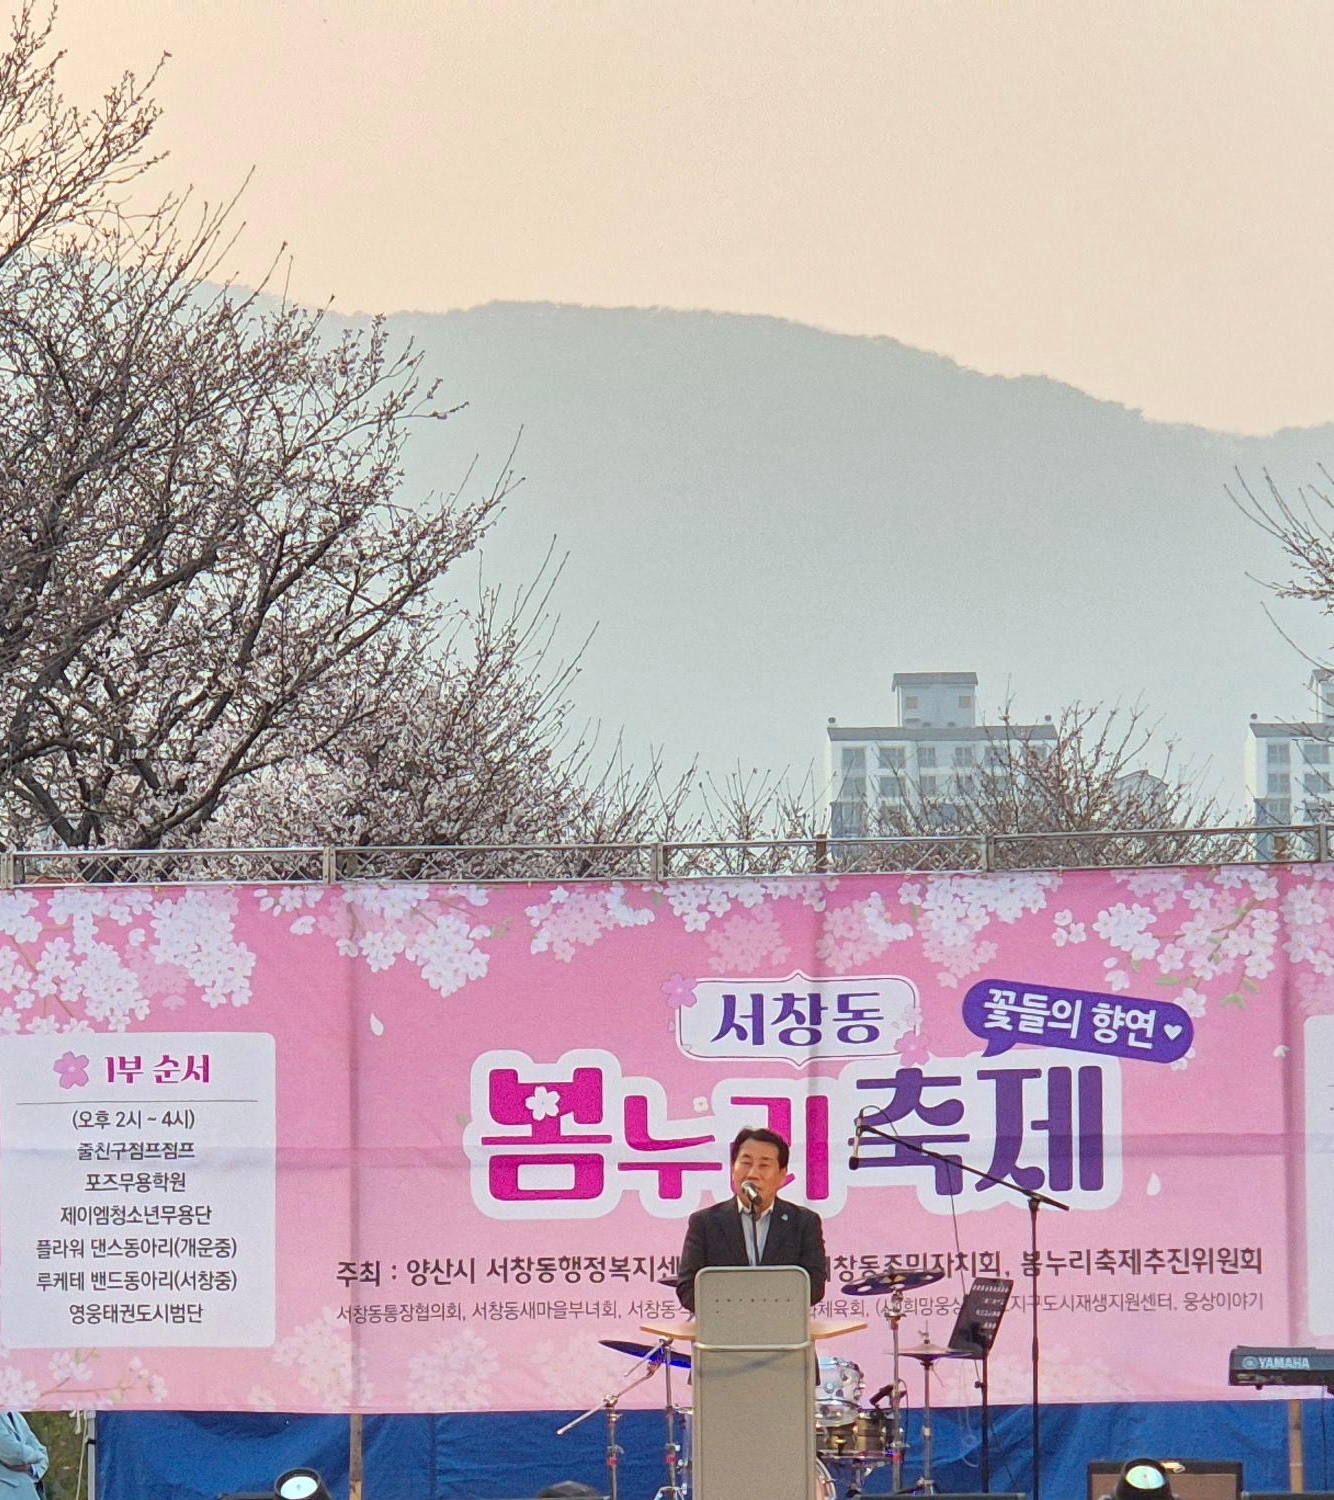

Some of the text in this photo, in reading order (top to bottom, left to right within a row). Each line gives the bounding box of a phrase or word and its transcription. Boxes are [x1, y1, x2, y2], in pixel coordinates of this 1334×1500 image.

[710, 991, 885, 1046] 서창동
[982, 986, 1158, 1051] 꽃들의 향연
[105, 1054, 210, 1084] 1부 순서
[72, 1109, 110, 1130] (오후
[115, 1110, 142, 1129] 2시
[161, 1109, 195, 1130] 4시)
[77, 1141, 195, 1161] 줄친구점프점프
[85, 1172, 186, 1193] 포즈무용학원
[60, 1205, 212, 1226] 제이엠청소년무용단
[36, 1237, 237, 1259] 플라워 댄스동아리(개운중)
[336, 1259, 381, 1288] 주최
[406, 1256, 476, 1286] 양산시
[1020, 1247, 1263, 1277] 봄누리축제추진위원회
[36, 1270, 237, 1292] 루케테 밴드동아리(서창중)
[1183, 1291, 1264, 1312] 웅상이야기
[69, 1303, 204, 1325] 영웅태권도시범단
[1258, 1356, 1310, 1370] YAMAHA
